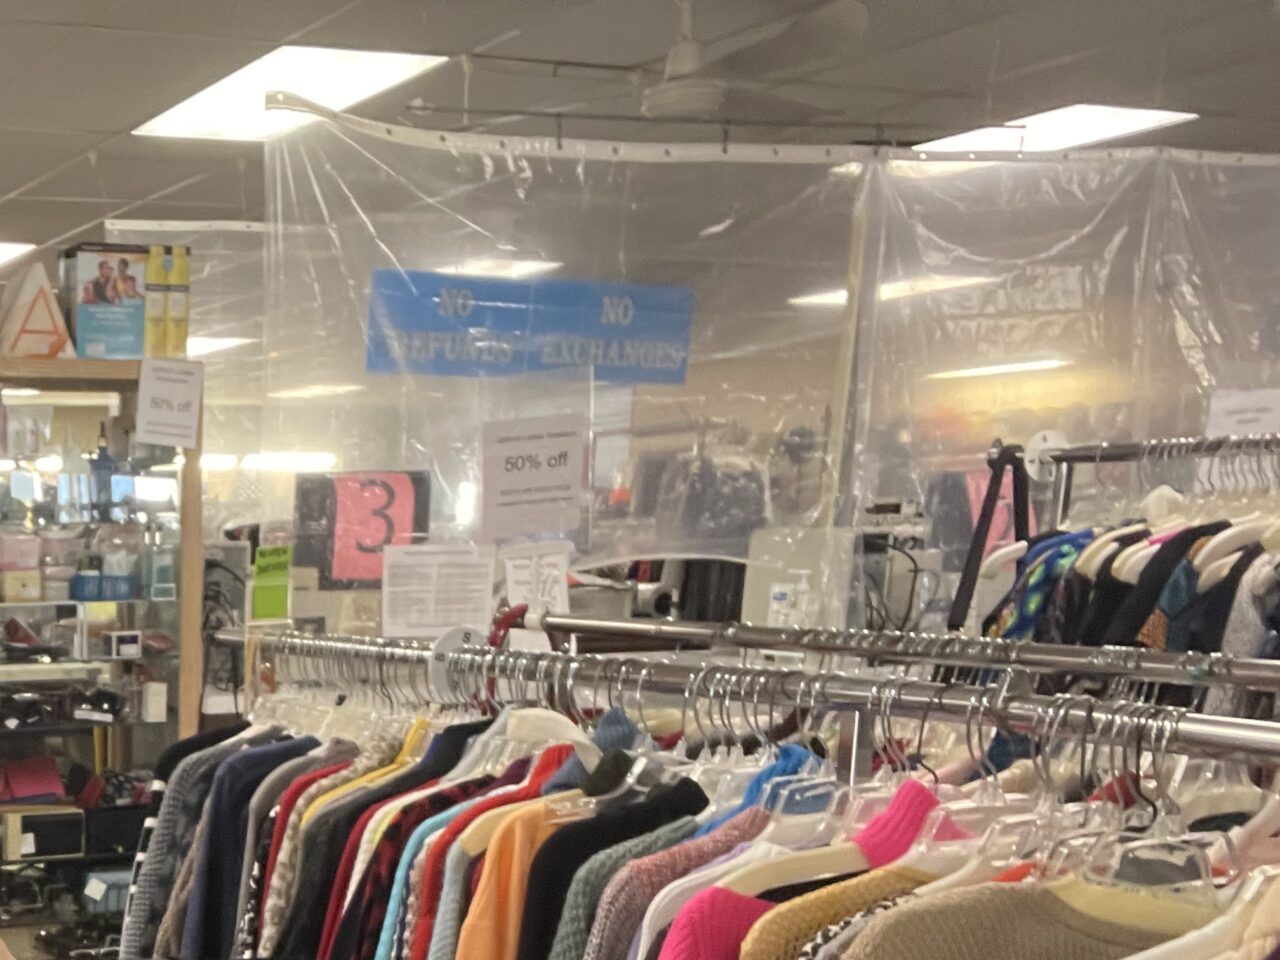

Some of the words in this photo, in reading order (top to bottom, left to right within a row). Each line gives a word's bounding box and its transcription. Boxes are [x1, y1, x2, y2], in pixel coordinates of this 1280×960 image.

[437, 287, 474, 317] NO
[601, 295, 635, 325] NO
[541, 333, 687, 370] EXCHANGES
[503, 453, 542, 473] 50%
[546, 450, 569, 468] off
[355, 478, 397, 553] 3
